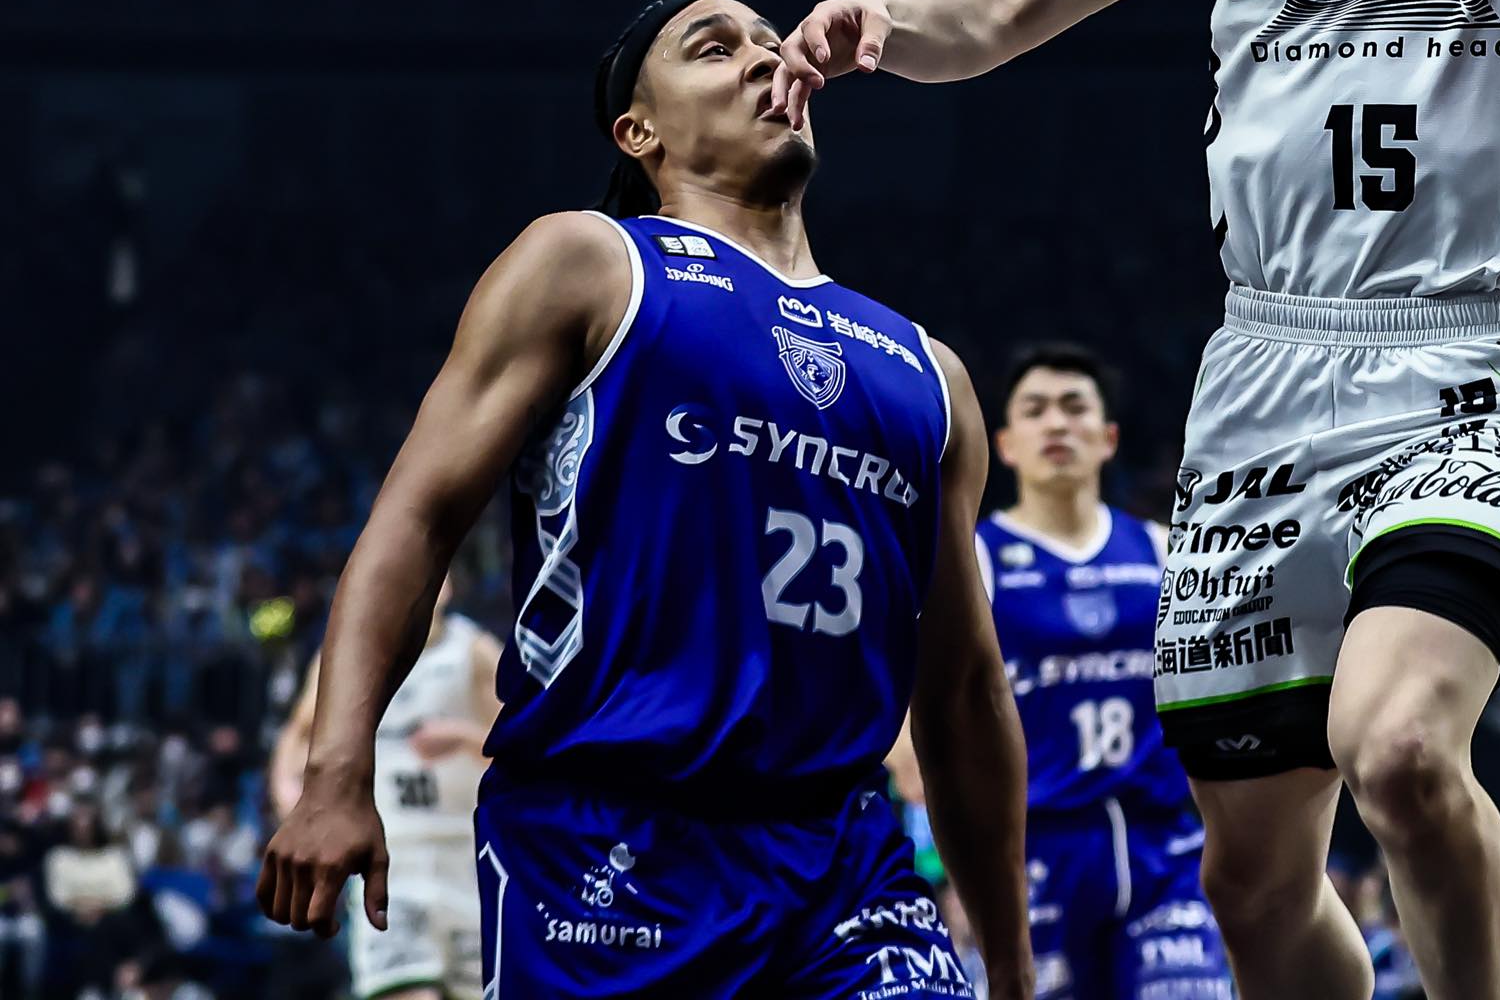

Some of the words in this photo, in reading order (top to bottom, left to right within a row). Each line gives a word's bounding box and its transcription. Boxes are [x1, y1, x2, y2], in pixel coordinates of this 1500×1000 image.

[1250, 36, 1404, 63] Diamond
[1323, 104, 1419, 211] 15
[665, 266, 734, 292] SPALDING
[1204, 463, 1307, 504] JAL
[761, 506, 864, 637] 23
[1176, 564, 1275, 604] Ohfuji
[1173, 608, 1231, 626] EDUCATION
[1070, 697, 1134, 771] 18
